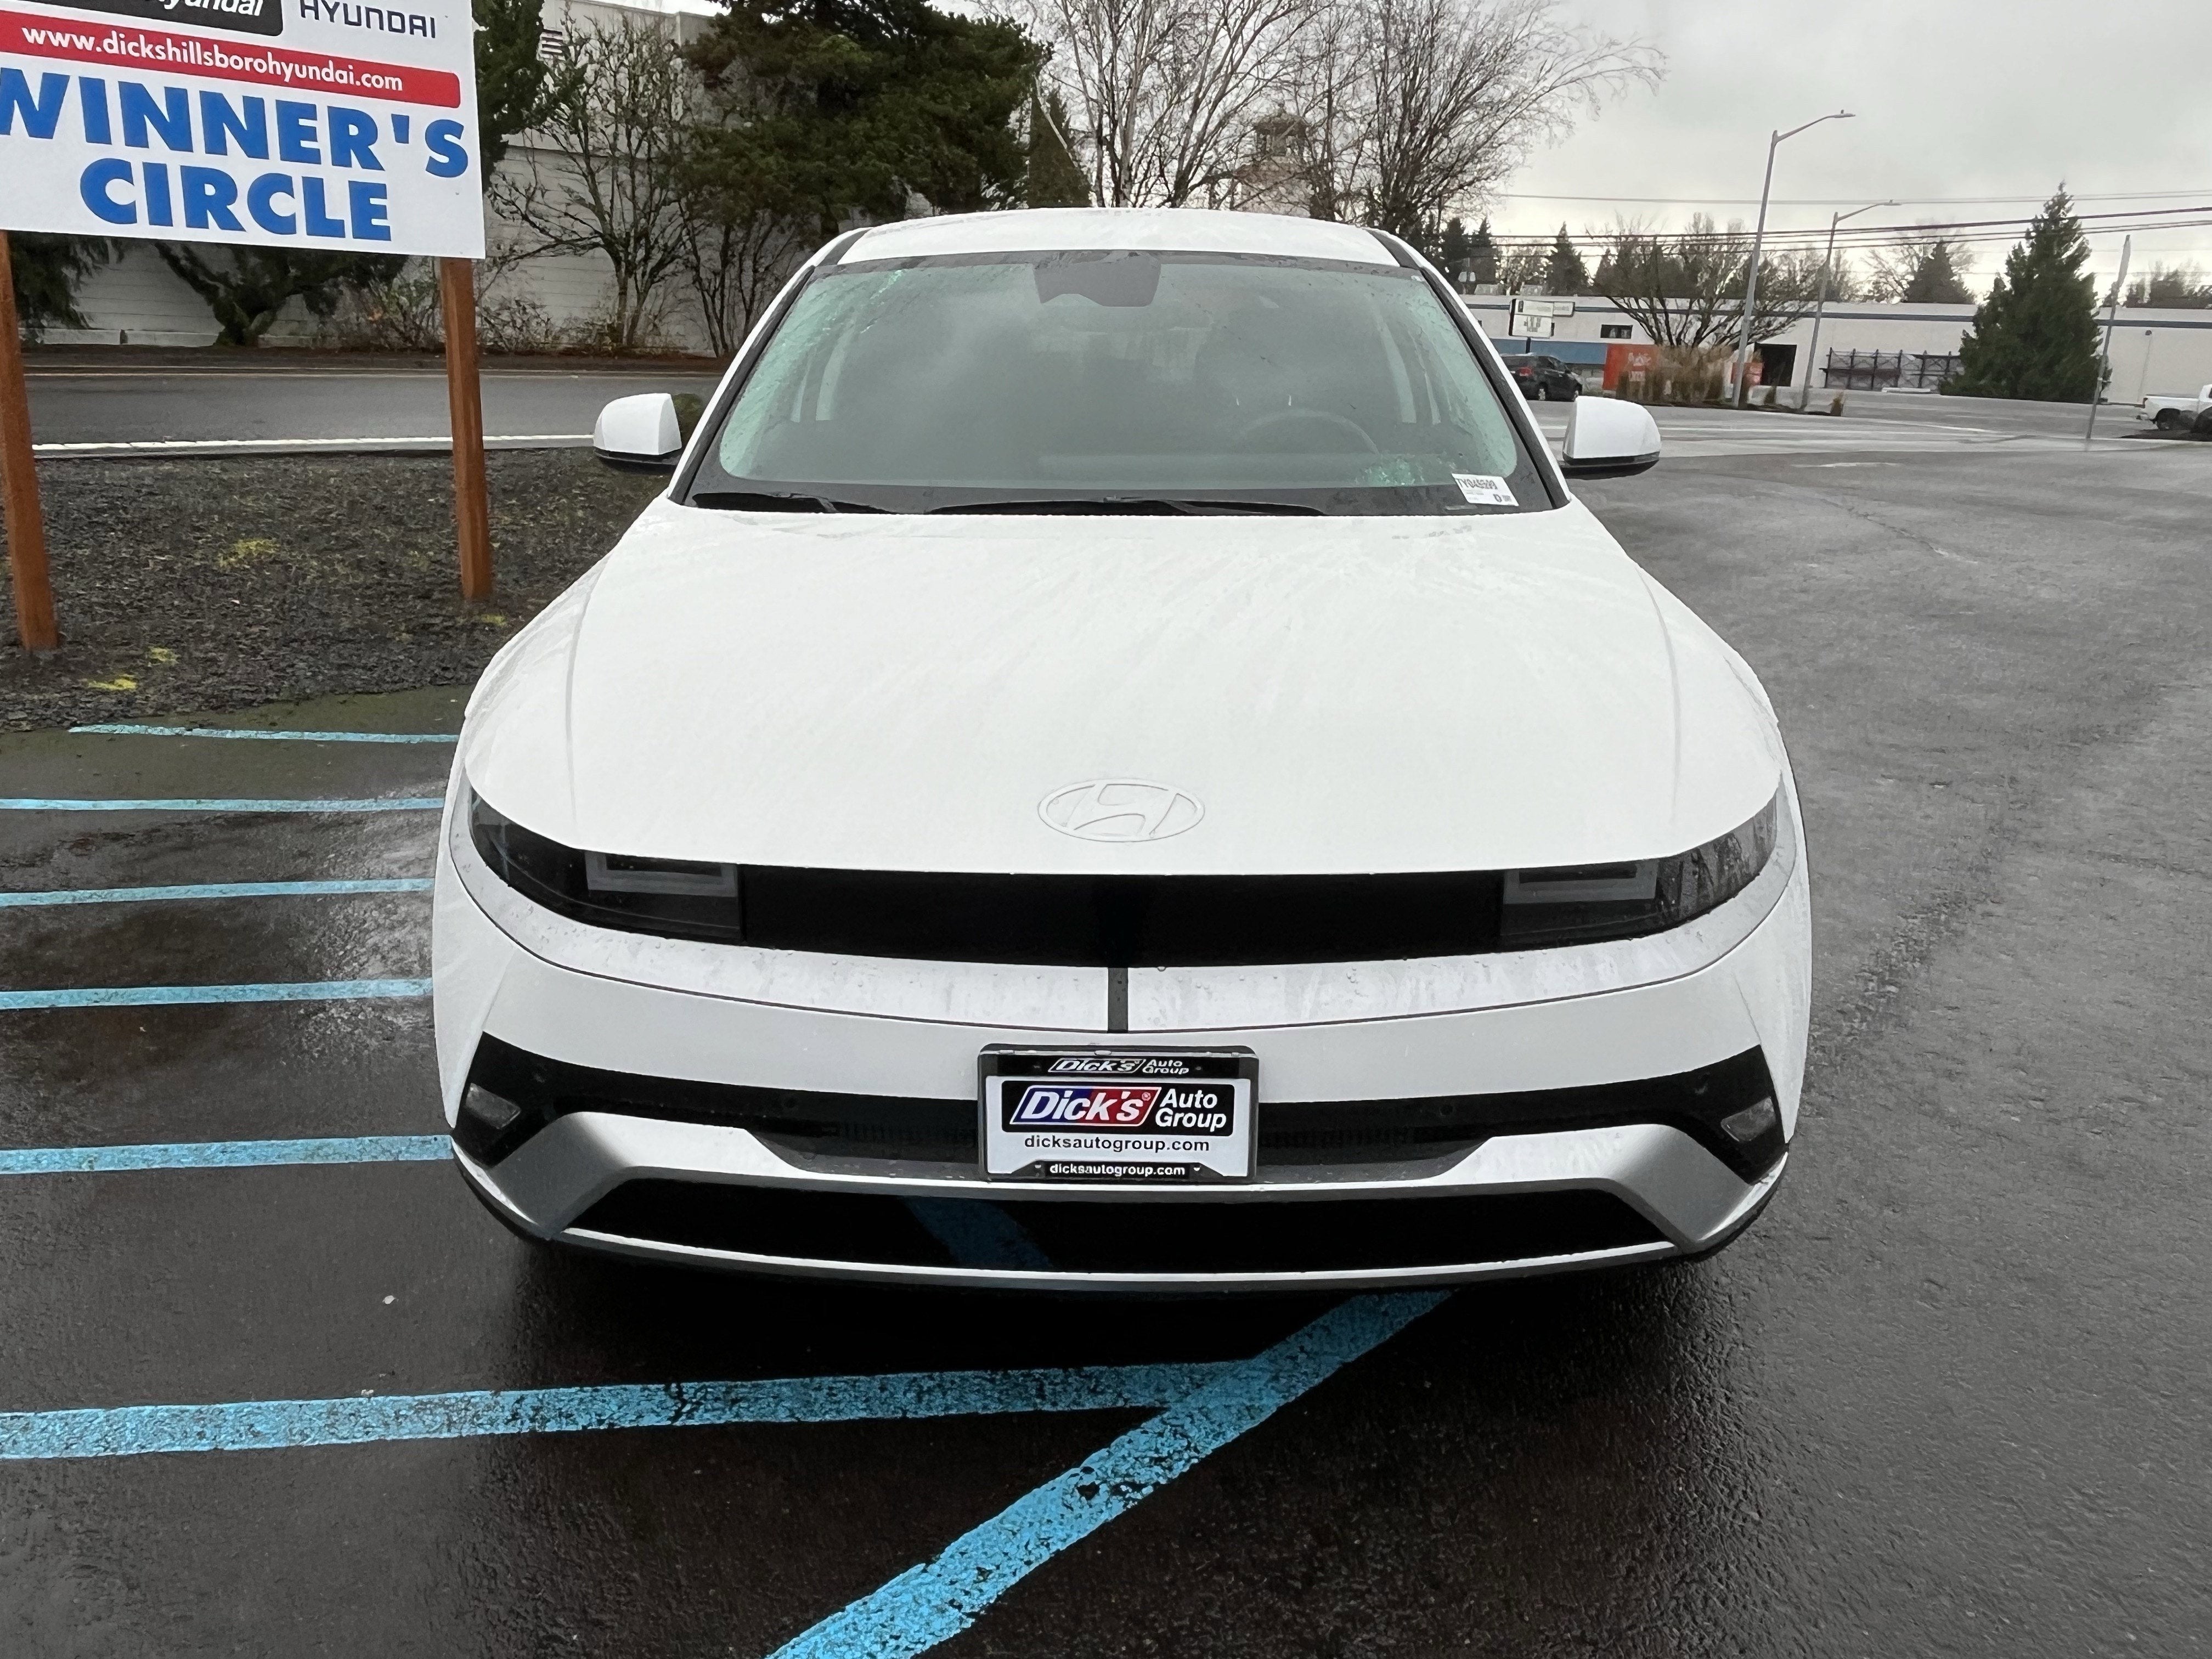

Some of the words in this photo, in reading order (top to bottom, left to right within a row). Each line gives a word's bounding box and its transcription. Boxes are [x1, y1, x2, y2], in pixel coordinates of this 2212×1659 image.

[300, 0, 436, 38] HYUNDAI
[21, 27, 403, 92] www.dickshillsborohyundai.com
[0, 67, 469, 178] WINNER'S
[80, 157, 392, 241] CIRCLE
[1142, 1066, 1189, 1075] Group
[1148, 1059, 1183, 1067] Auto
[1160, 1088, 1218, 1109] Auto
[1155, 1108, 1227, 1132] Group
[1024, 1135, 1210, 1153] dicksautogroup.com
[1049, 1161, 1186, 1176] dicksautogroup.com
